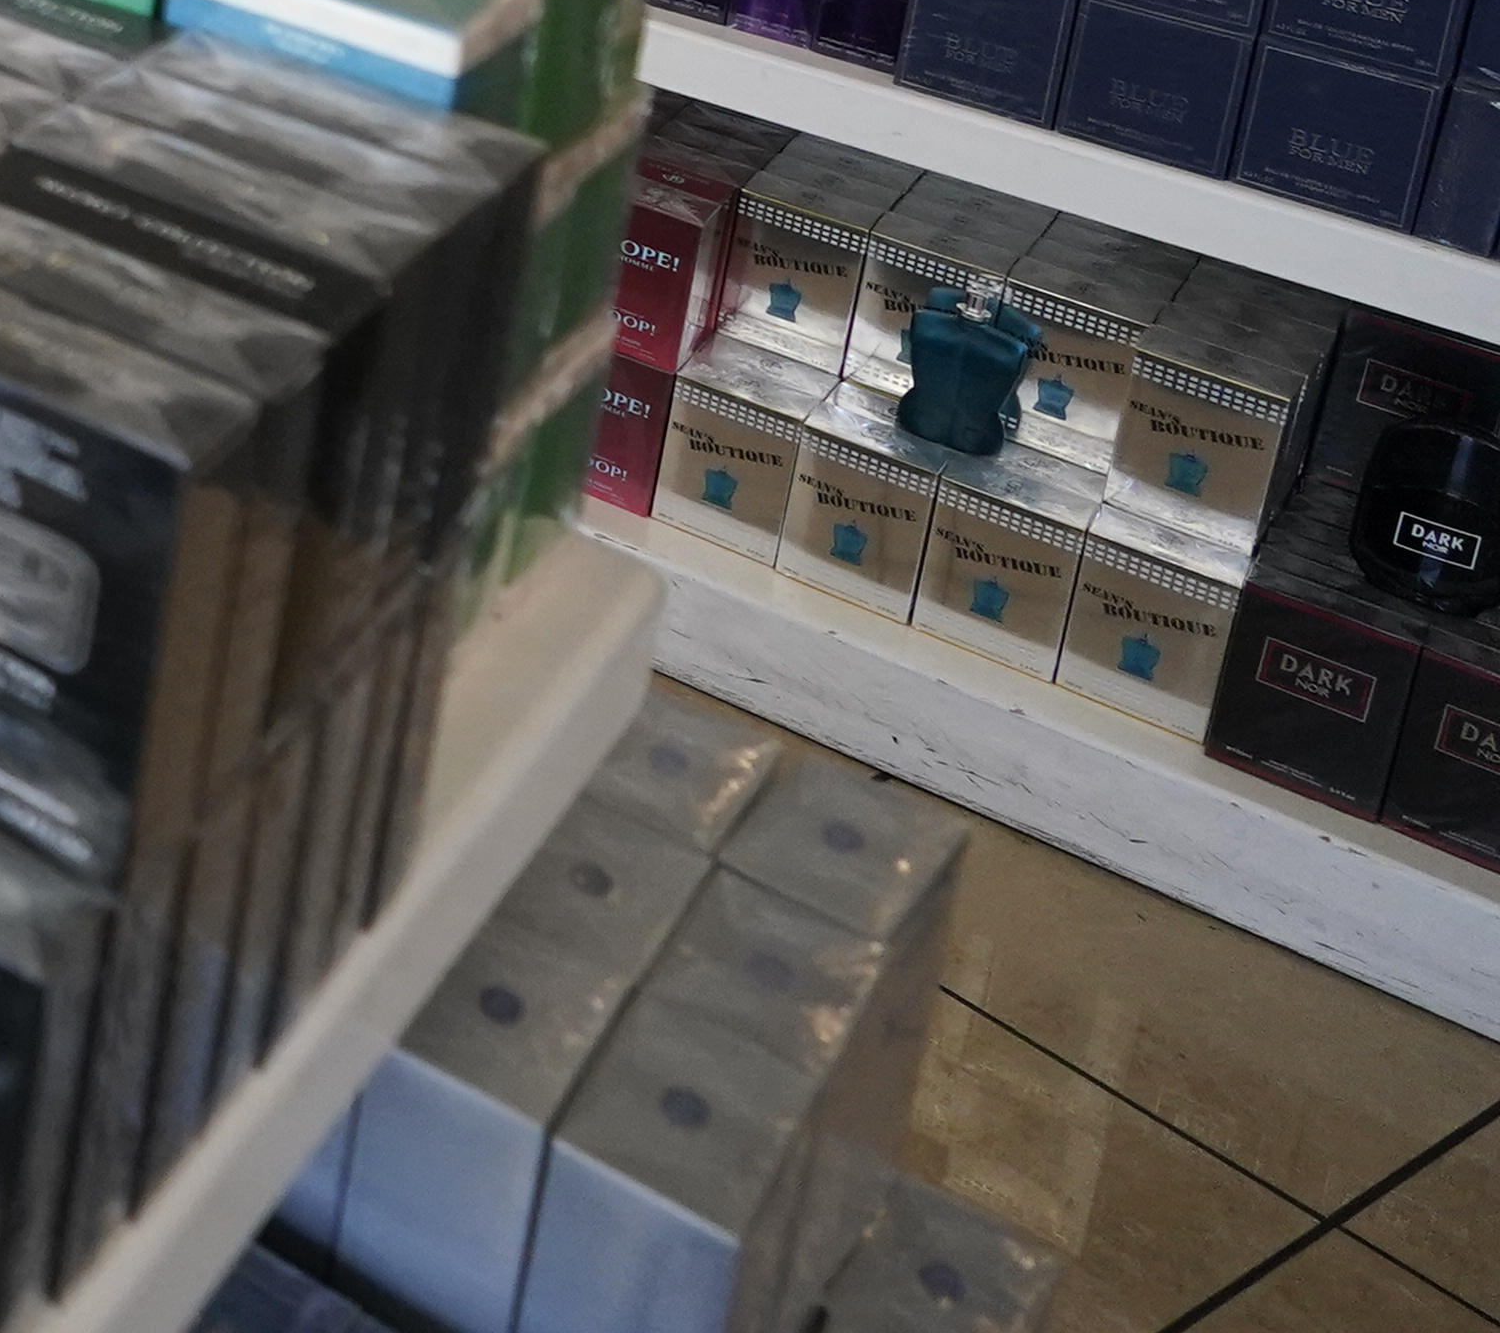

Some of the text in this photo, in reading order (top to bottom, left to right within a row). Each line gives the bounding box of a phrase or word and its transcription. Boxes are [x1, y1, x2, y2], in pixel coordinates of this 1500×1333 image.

[1359, 1, 1404, 25] MEN
[620, 238, 681, 273] OPE!
[1129, 399, 1182, 428] SEAN'S
[1150, 418, 1265, 453] BOUTIQUE
[817, 490, 917, 524] BOUTIQUE
[1411, 523, 1464, 552] DARK
[1082, 580, 1133, 610] SEAN'S
[1103, 601, 1218, 639] BOUTIQUE
[1278, 652, 1352, 696] DARK
